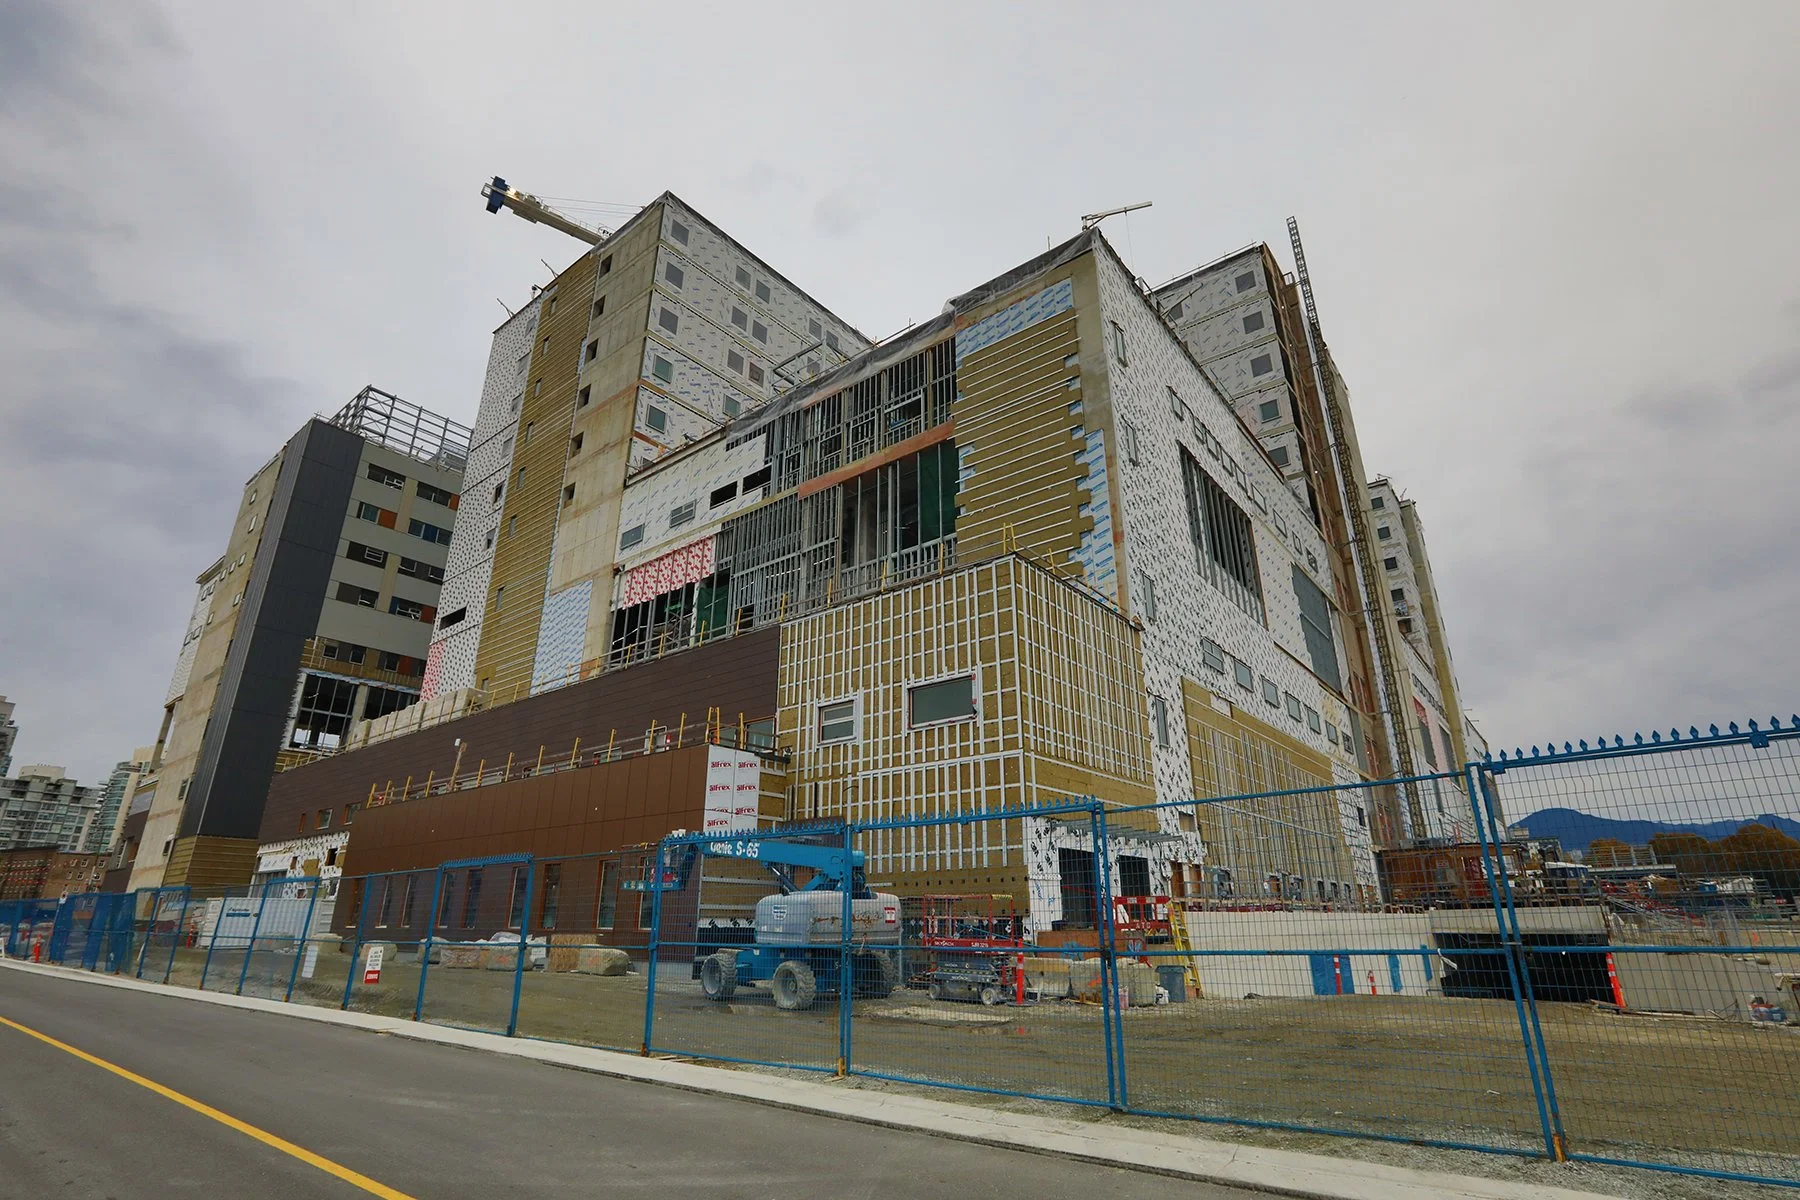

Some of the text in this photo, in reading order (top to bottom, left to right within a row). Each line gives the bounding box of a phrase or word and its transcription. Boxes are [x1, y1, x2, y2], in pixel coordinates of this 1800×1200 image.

[738, 761, 757, 769] alfrex
[709, 784, 731, 792] alfrex
[736, 784, 757, 792] alfrex
[735, 807, 755, 815] alfrex
[707, 819, 728, 827] alfrex
